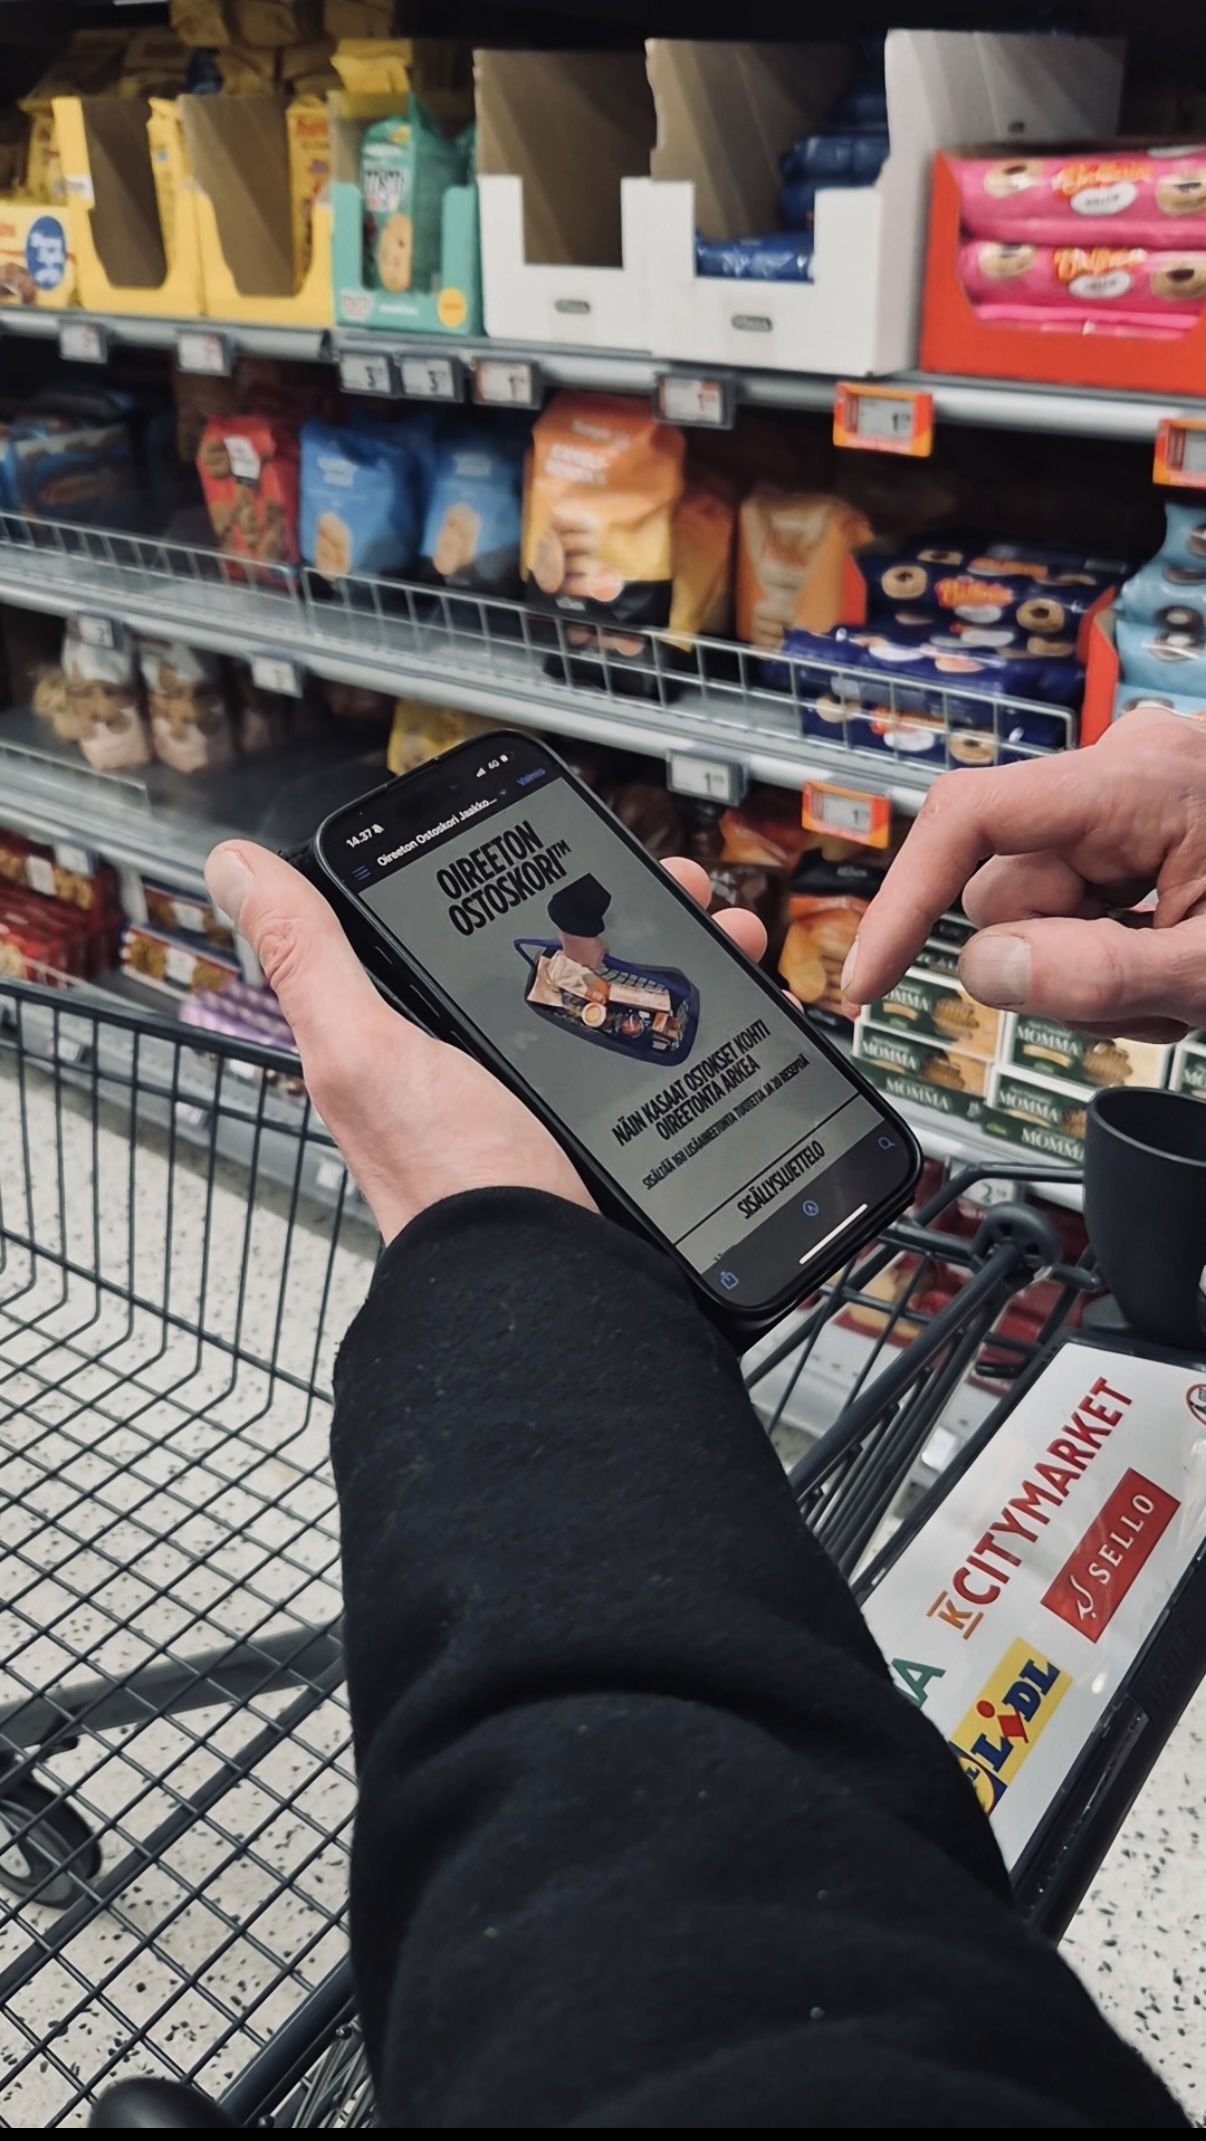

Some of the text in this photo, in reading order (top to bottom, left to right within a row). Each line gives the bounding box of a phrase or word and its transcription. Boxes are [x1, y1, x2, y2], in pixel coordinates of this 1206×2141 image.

[346, 829, 374, 848] 14.37
[377, 840, 418, 867] Oireeton
[416, 814, 460, 845] Ostoskori
[436, 820, 544, 900] OIREETON
[882, 987, 930, 1012] OMMA
[861, 1040, 917, 1072] MOMMA
[1017, 1025, 1080, 1057] MOMMA
[611, 1018, 772, 1147] NÄIN KASAAT OSTOKSET KOHTI
[656, 1054, 761, 1141] OIREETONTA ARKEA
[763, 1083, 776, 1097] JA
[769, 1075, 784, 1091] 20
[885, 1077, 950, 1111] MOMMA
[998, 1090, 1059, 1123] MOMMA
[736, 1140, 826, 1220] SISÄLLYSLUETTELO
[952, 1376, 1133, 1606] CITYMARKET
[1088, 1493, 1155, 1585] SELLO
